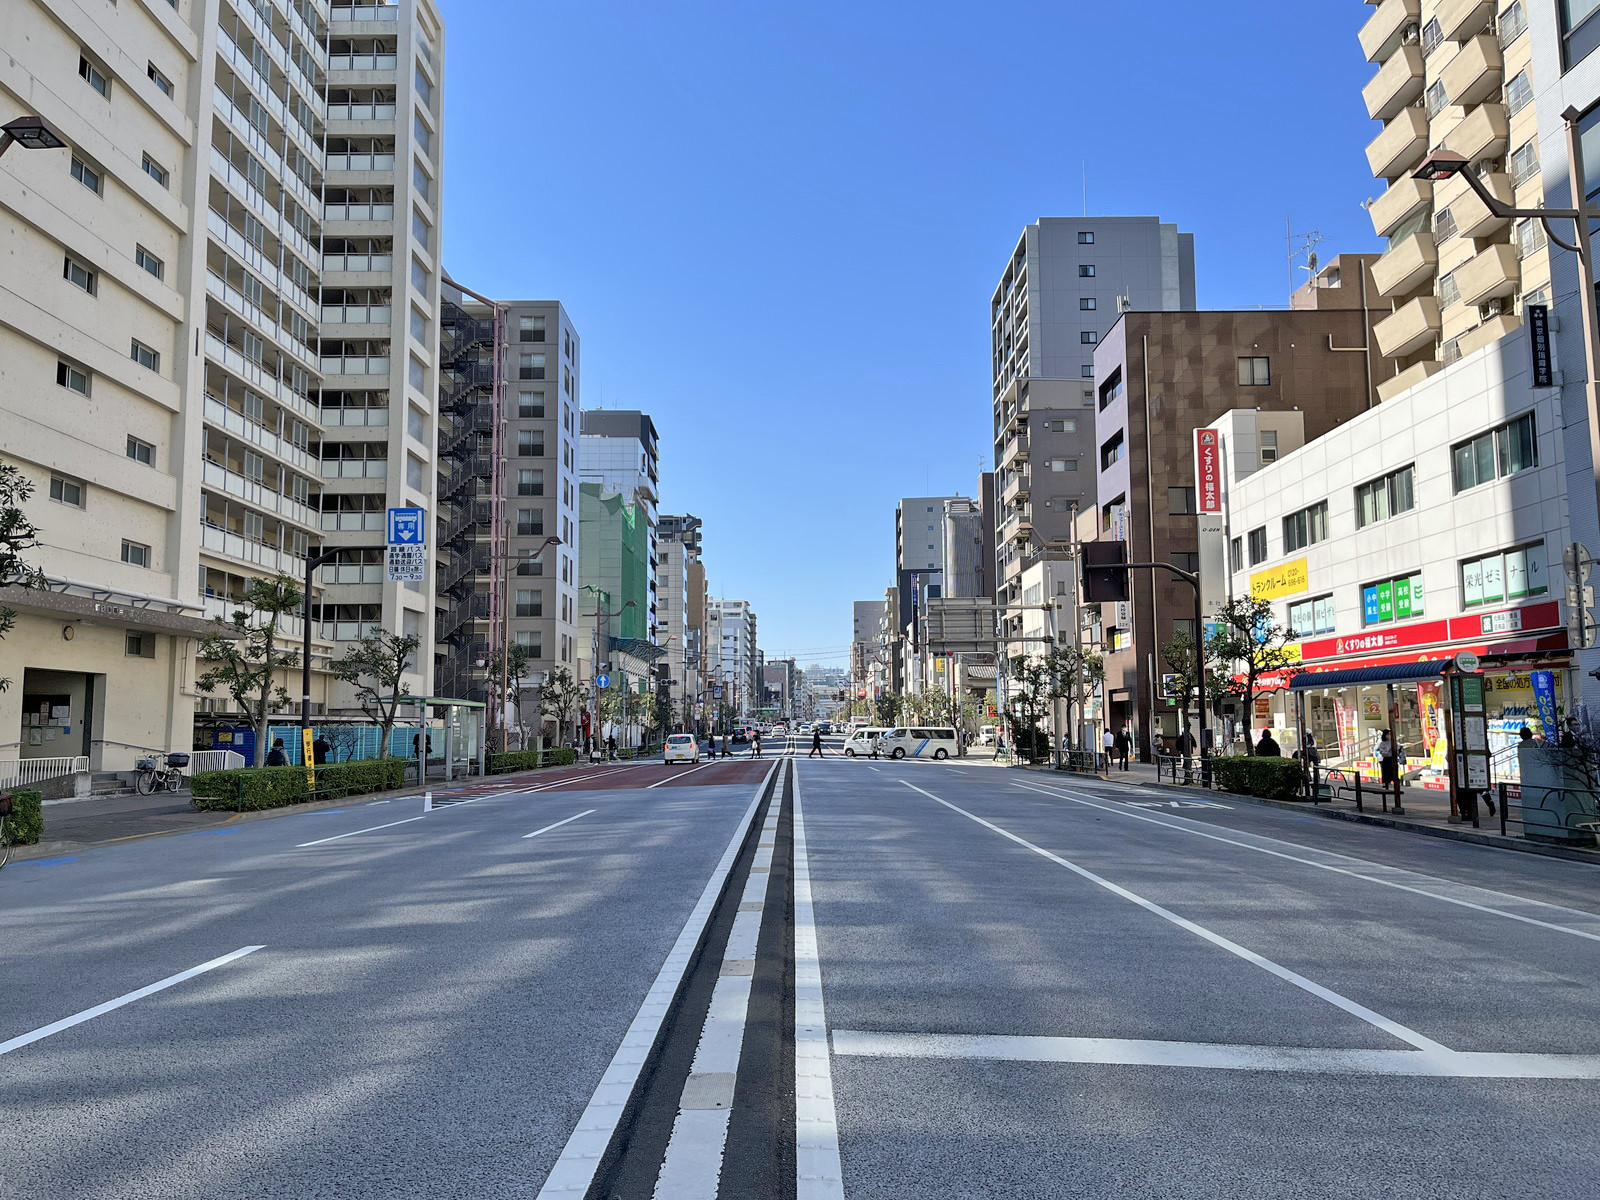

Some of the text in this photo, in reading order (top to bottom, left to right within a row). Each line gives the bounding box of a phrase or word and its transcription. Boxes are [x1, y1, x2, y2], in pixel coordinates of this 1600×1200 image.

[1203, 447, 1216, 509] くすりの福太郎
[397, 522, 415, 530] 専用
[1465, 560, 1540, 588] 栄光ゼミナール
[1252, 574, 1287, 595] トランクルーム
[1397, 585, 1409, 597] 高校
[1380, 589, 1391, 600] 中学
[1344, 635, 1384, 651] くすりの福太郎
